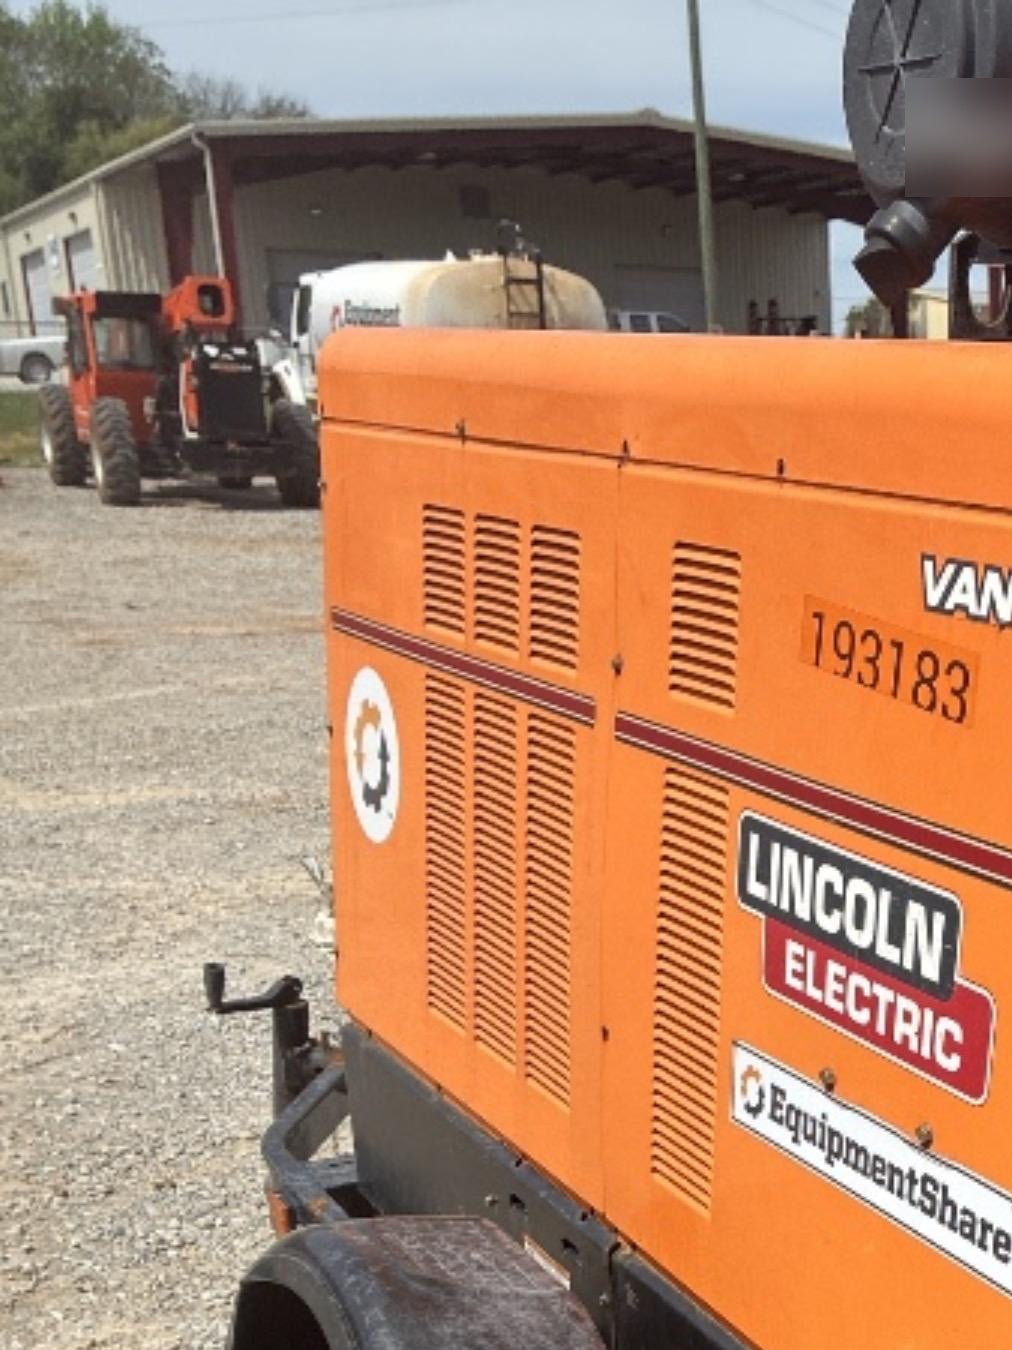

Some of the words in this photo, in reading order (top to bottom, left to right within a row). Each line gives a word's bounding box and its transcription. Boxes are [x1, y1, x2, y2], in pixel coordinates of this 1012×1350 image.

[810, 610, 972, 724] 193183
[745, 831, 946, 983] LINCOLN
[784, 937, 965, 1073] ELECTRIC
[768, 1083, 1012, 1264] EquipmentShare
